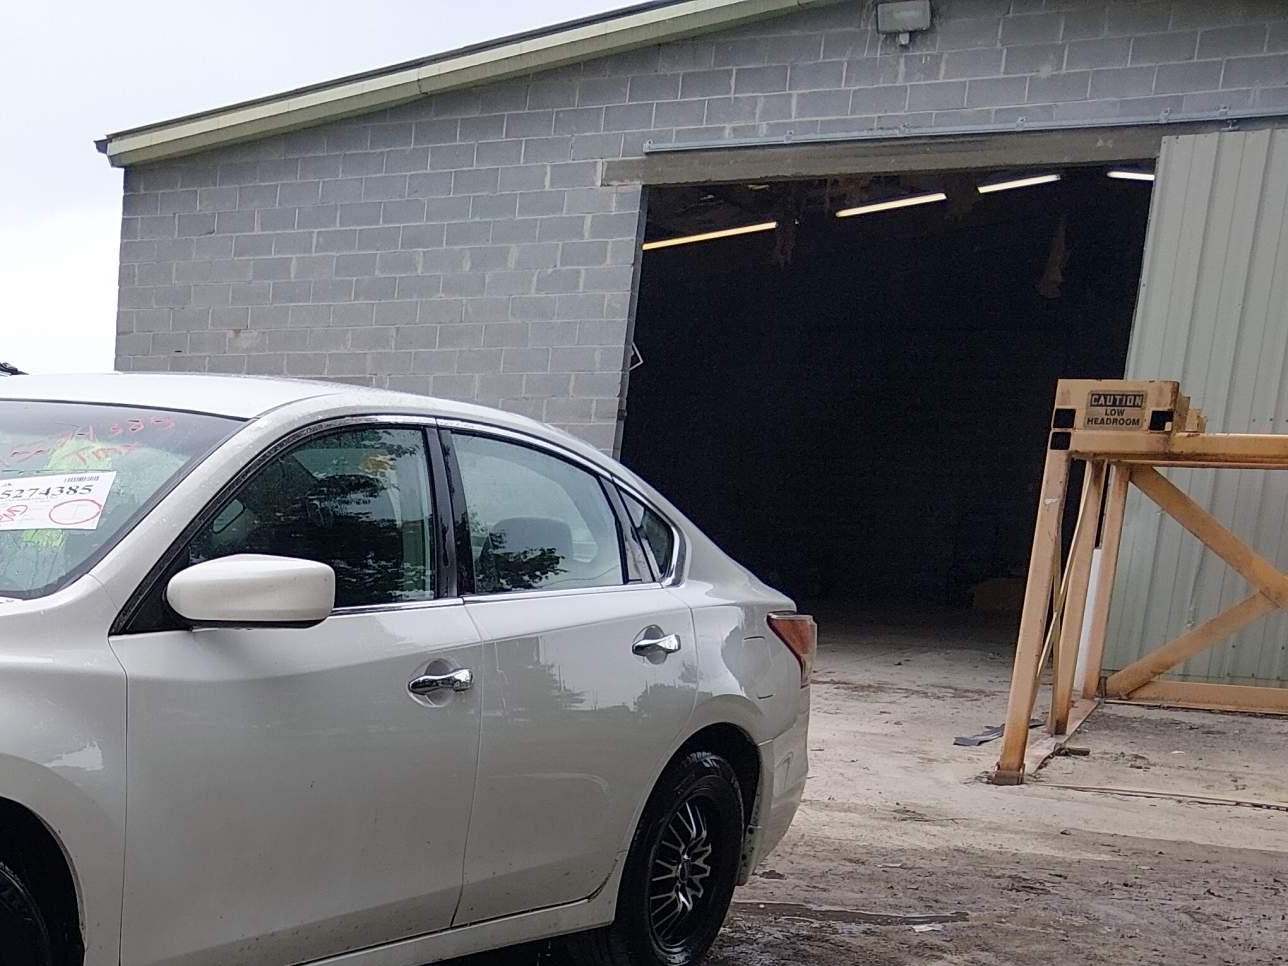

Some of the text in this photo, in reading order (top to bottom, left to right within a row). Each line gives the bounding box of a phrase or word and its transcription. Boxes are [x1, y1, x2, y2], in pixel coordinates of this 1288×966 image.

[1091, 394, 1144, 406] CAUTION
[1104, 408, 1125, 416] LOW
[1086, 417, 1140, 426] HEADROOM
